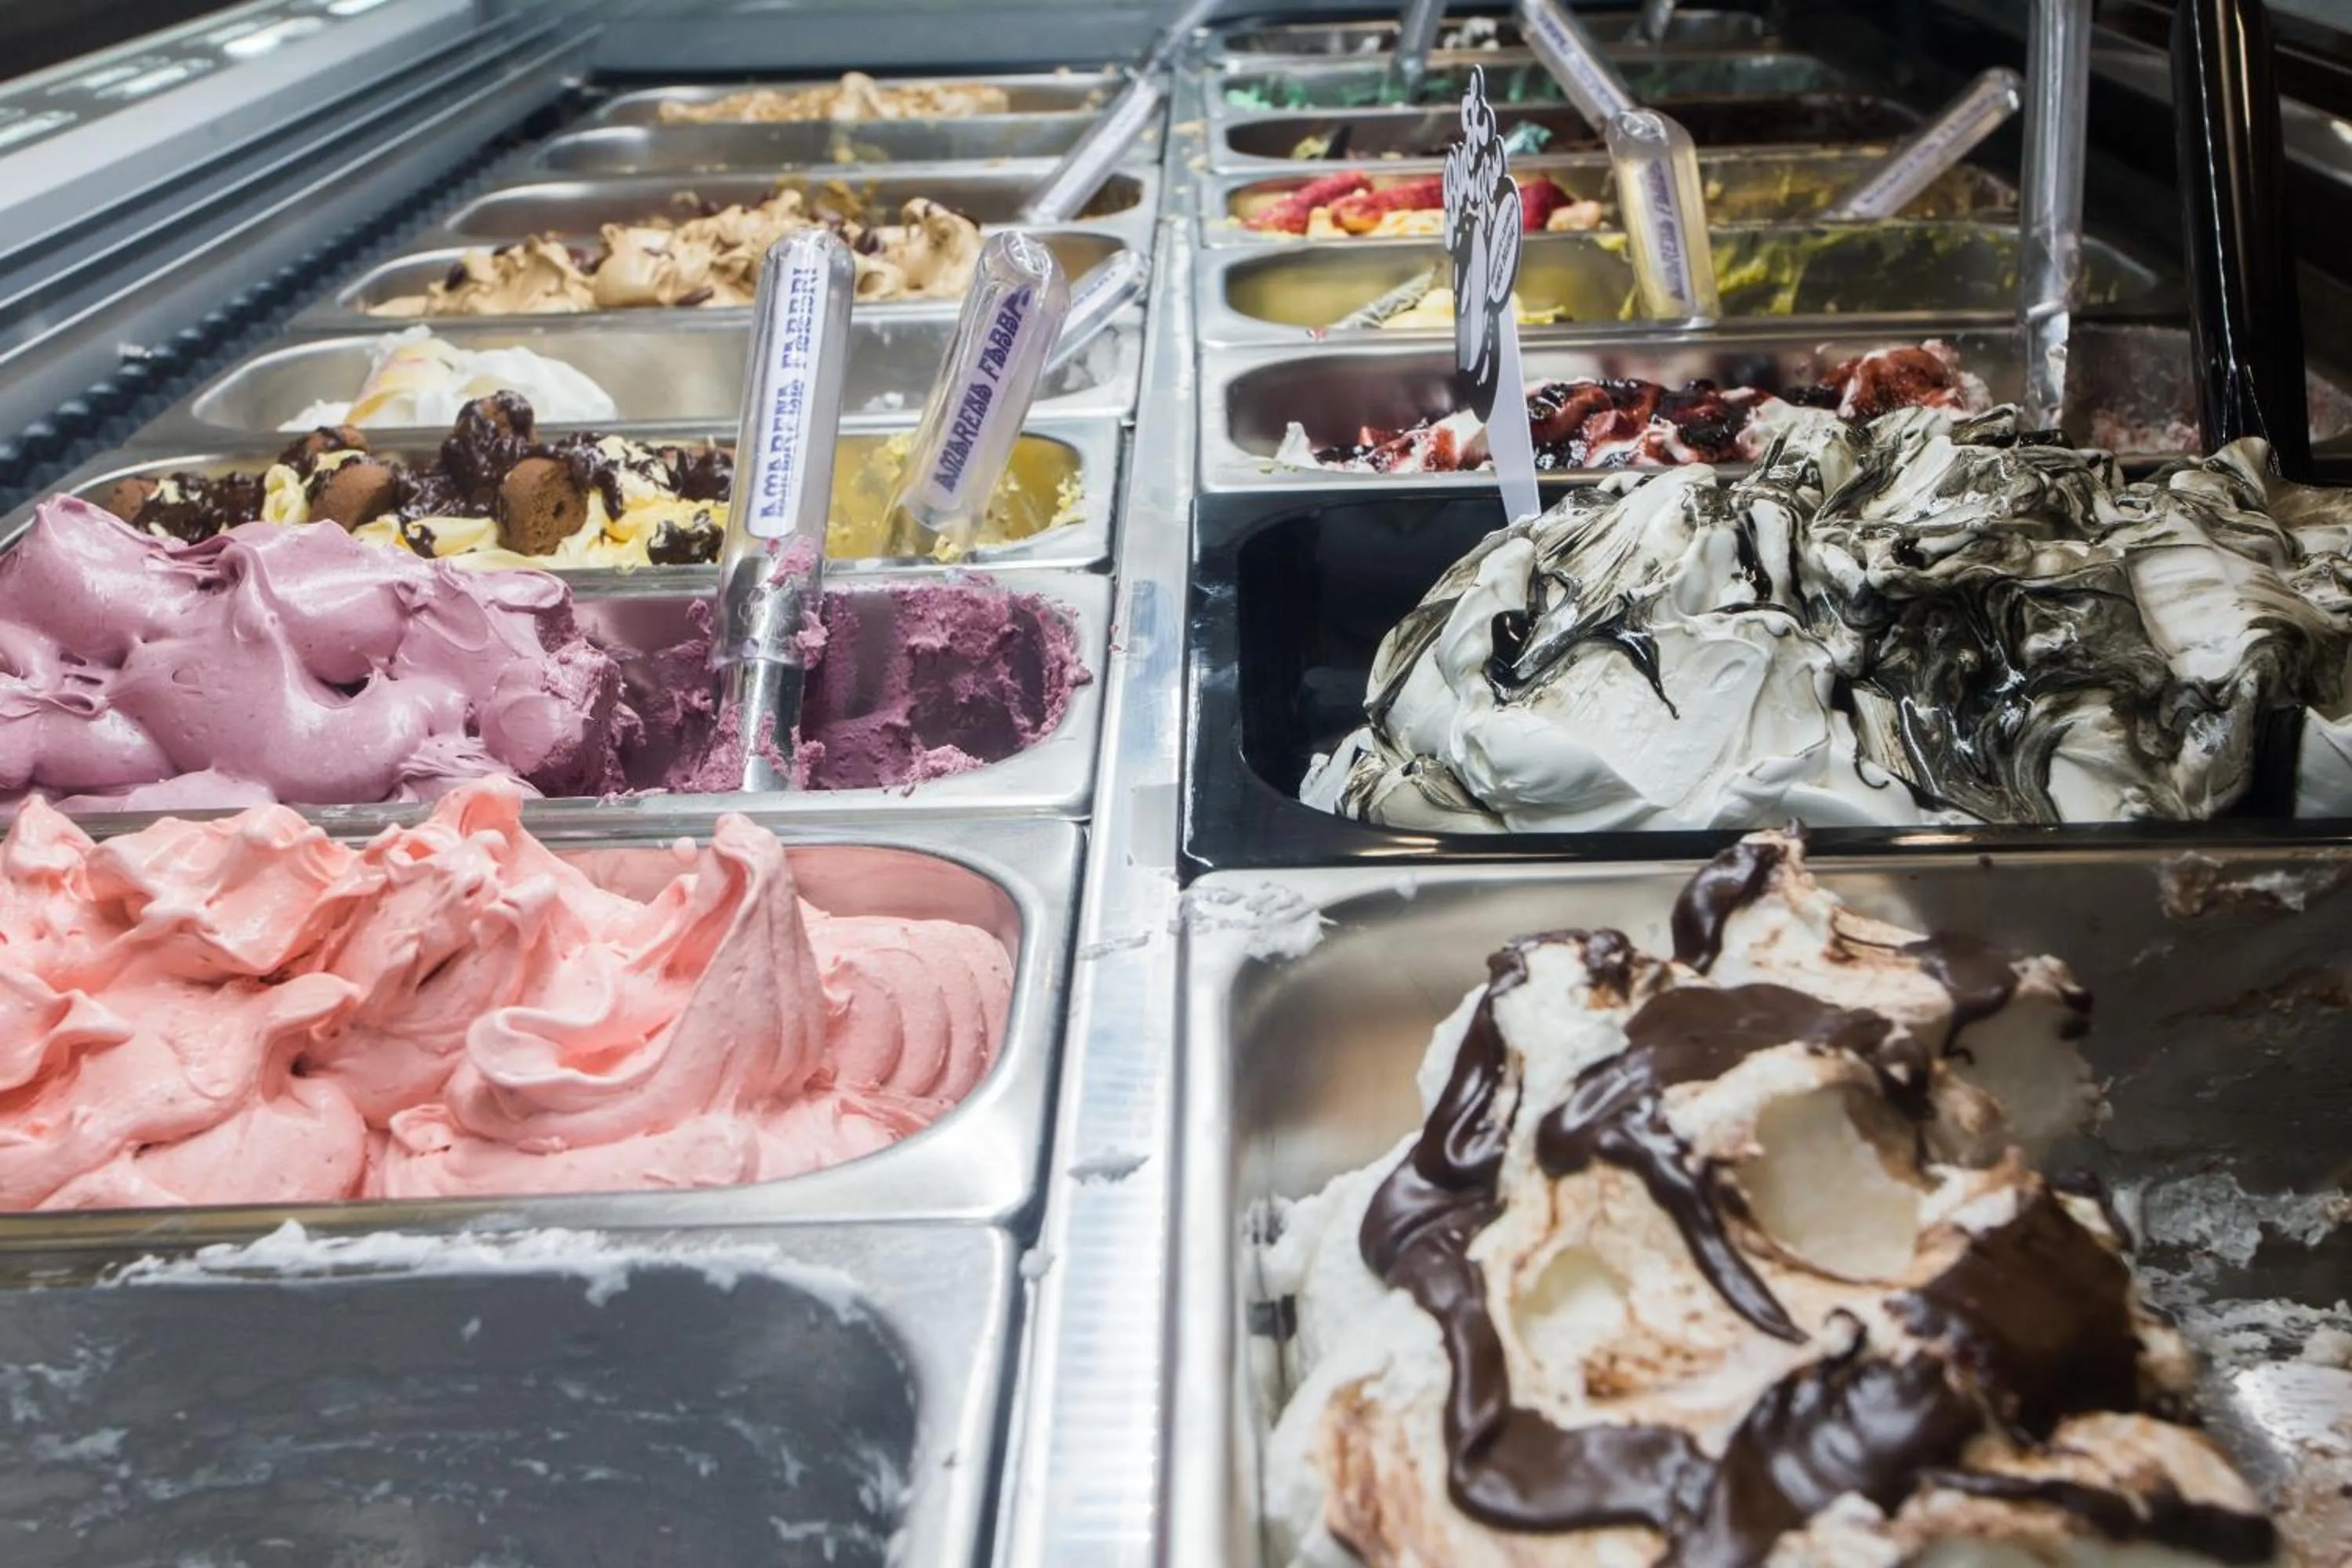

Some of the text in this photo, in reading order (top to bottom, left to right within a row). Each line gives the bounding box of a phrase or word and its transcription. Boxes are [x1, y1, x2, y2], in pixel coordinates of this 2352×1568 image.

[760, 267, 818, 518] AMARENA FABBRI
[933, 382, 993, 493] AMARENA
